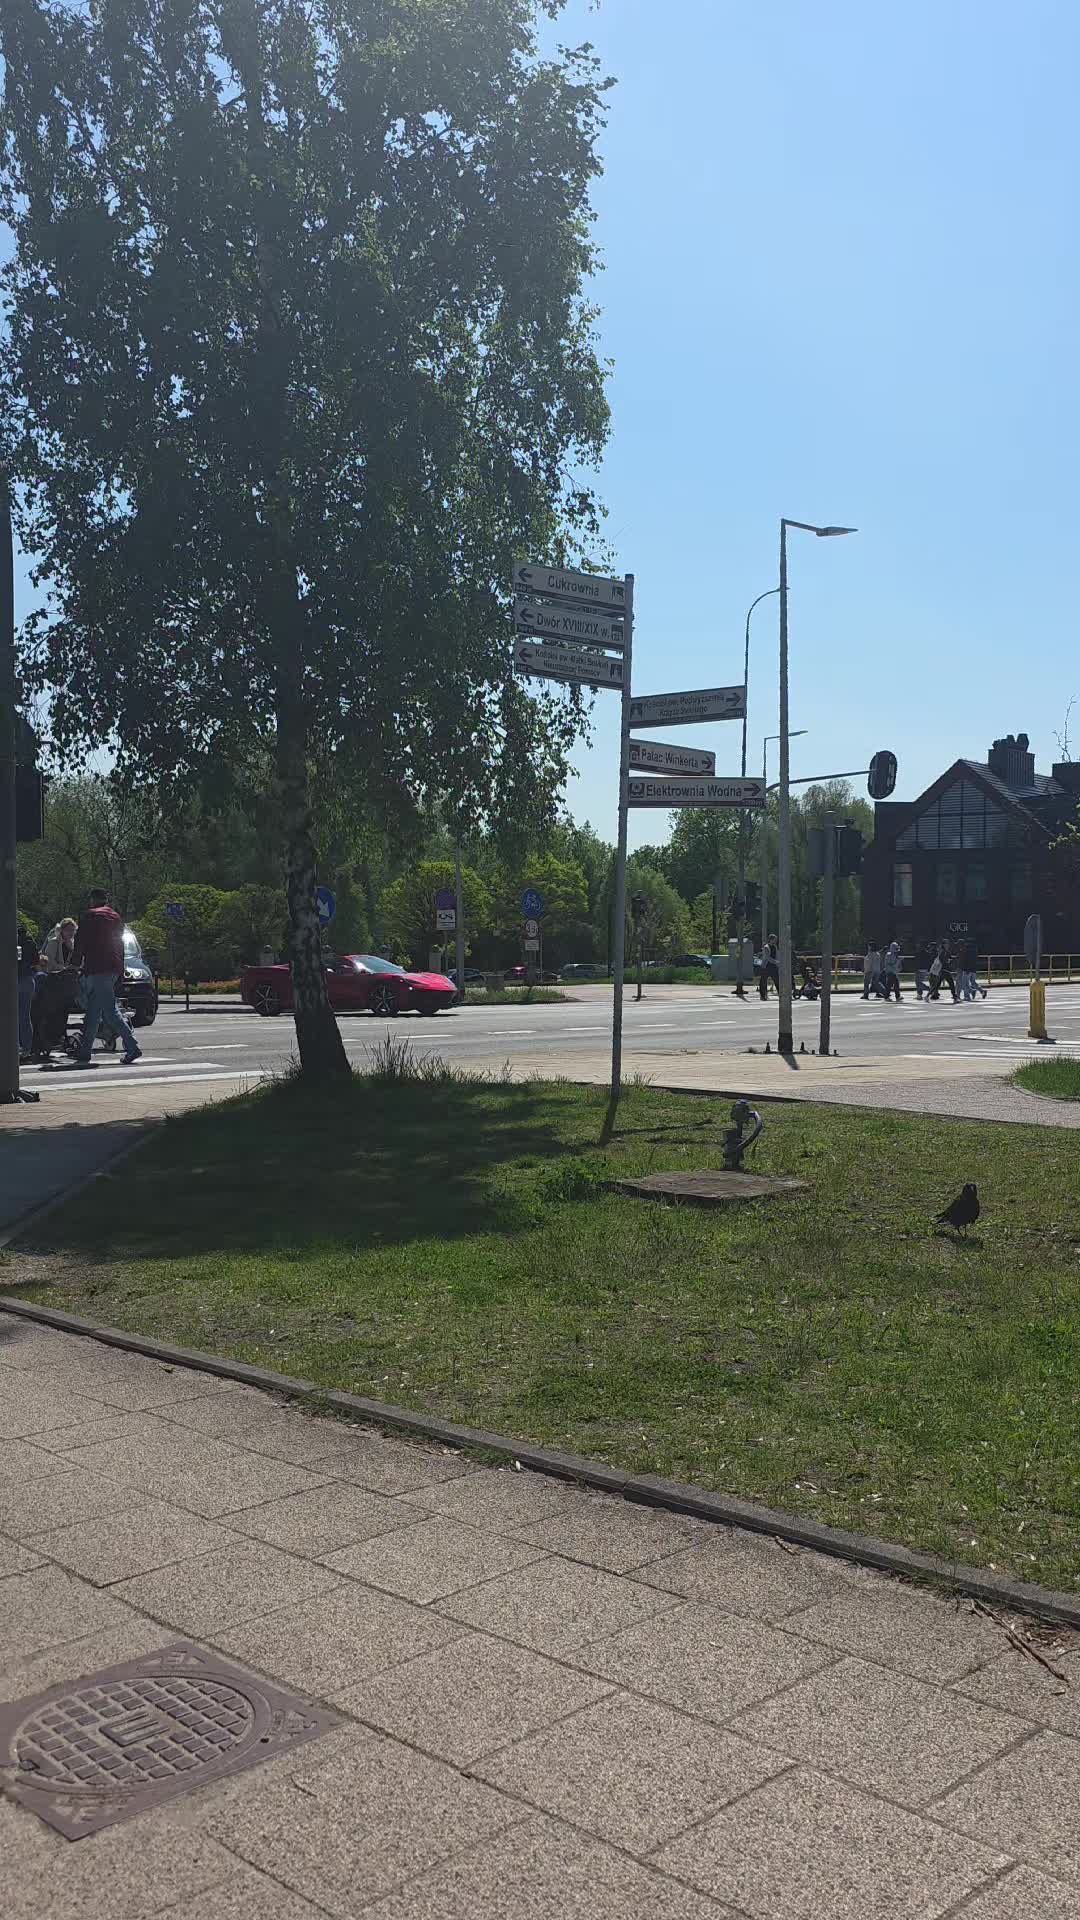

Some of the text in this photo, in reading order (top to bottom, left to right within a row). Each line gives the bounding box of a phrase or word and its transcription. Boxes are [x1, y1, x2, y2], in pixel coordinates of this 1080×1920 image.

[548, 575, 600, 597] Cukrownia
[536, 613, 560, 630] Dwór
[646, 784, 742, 797] Elektrownia Wodna
